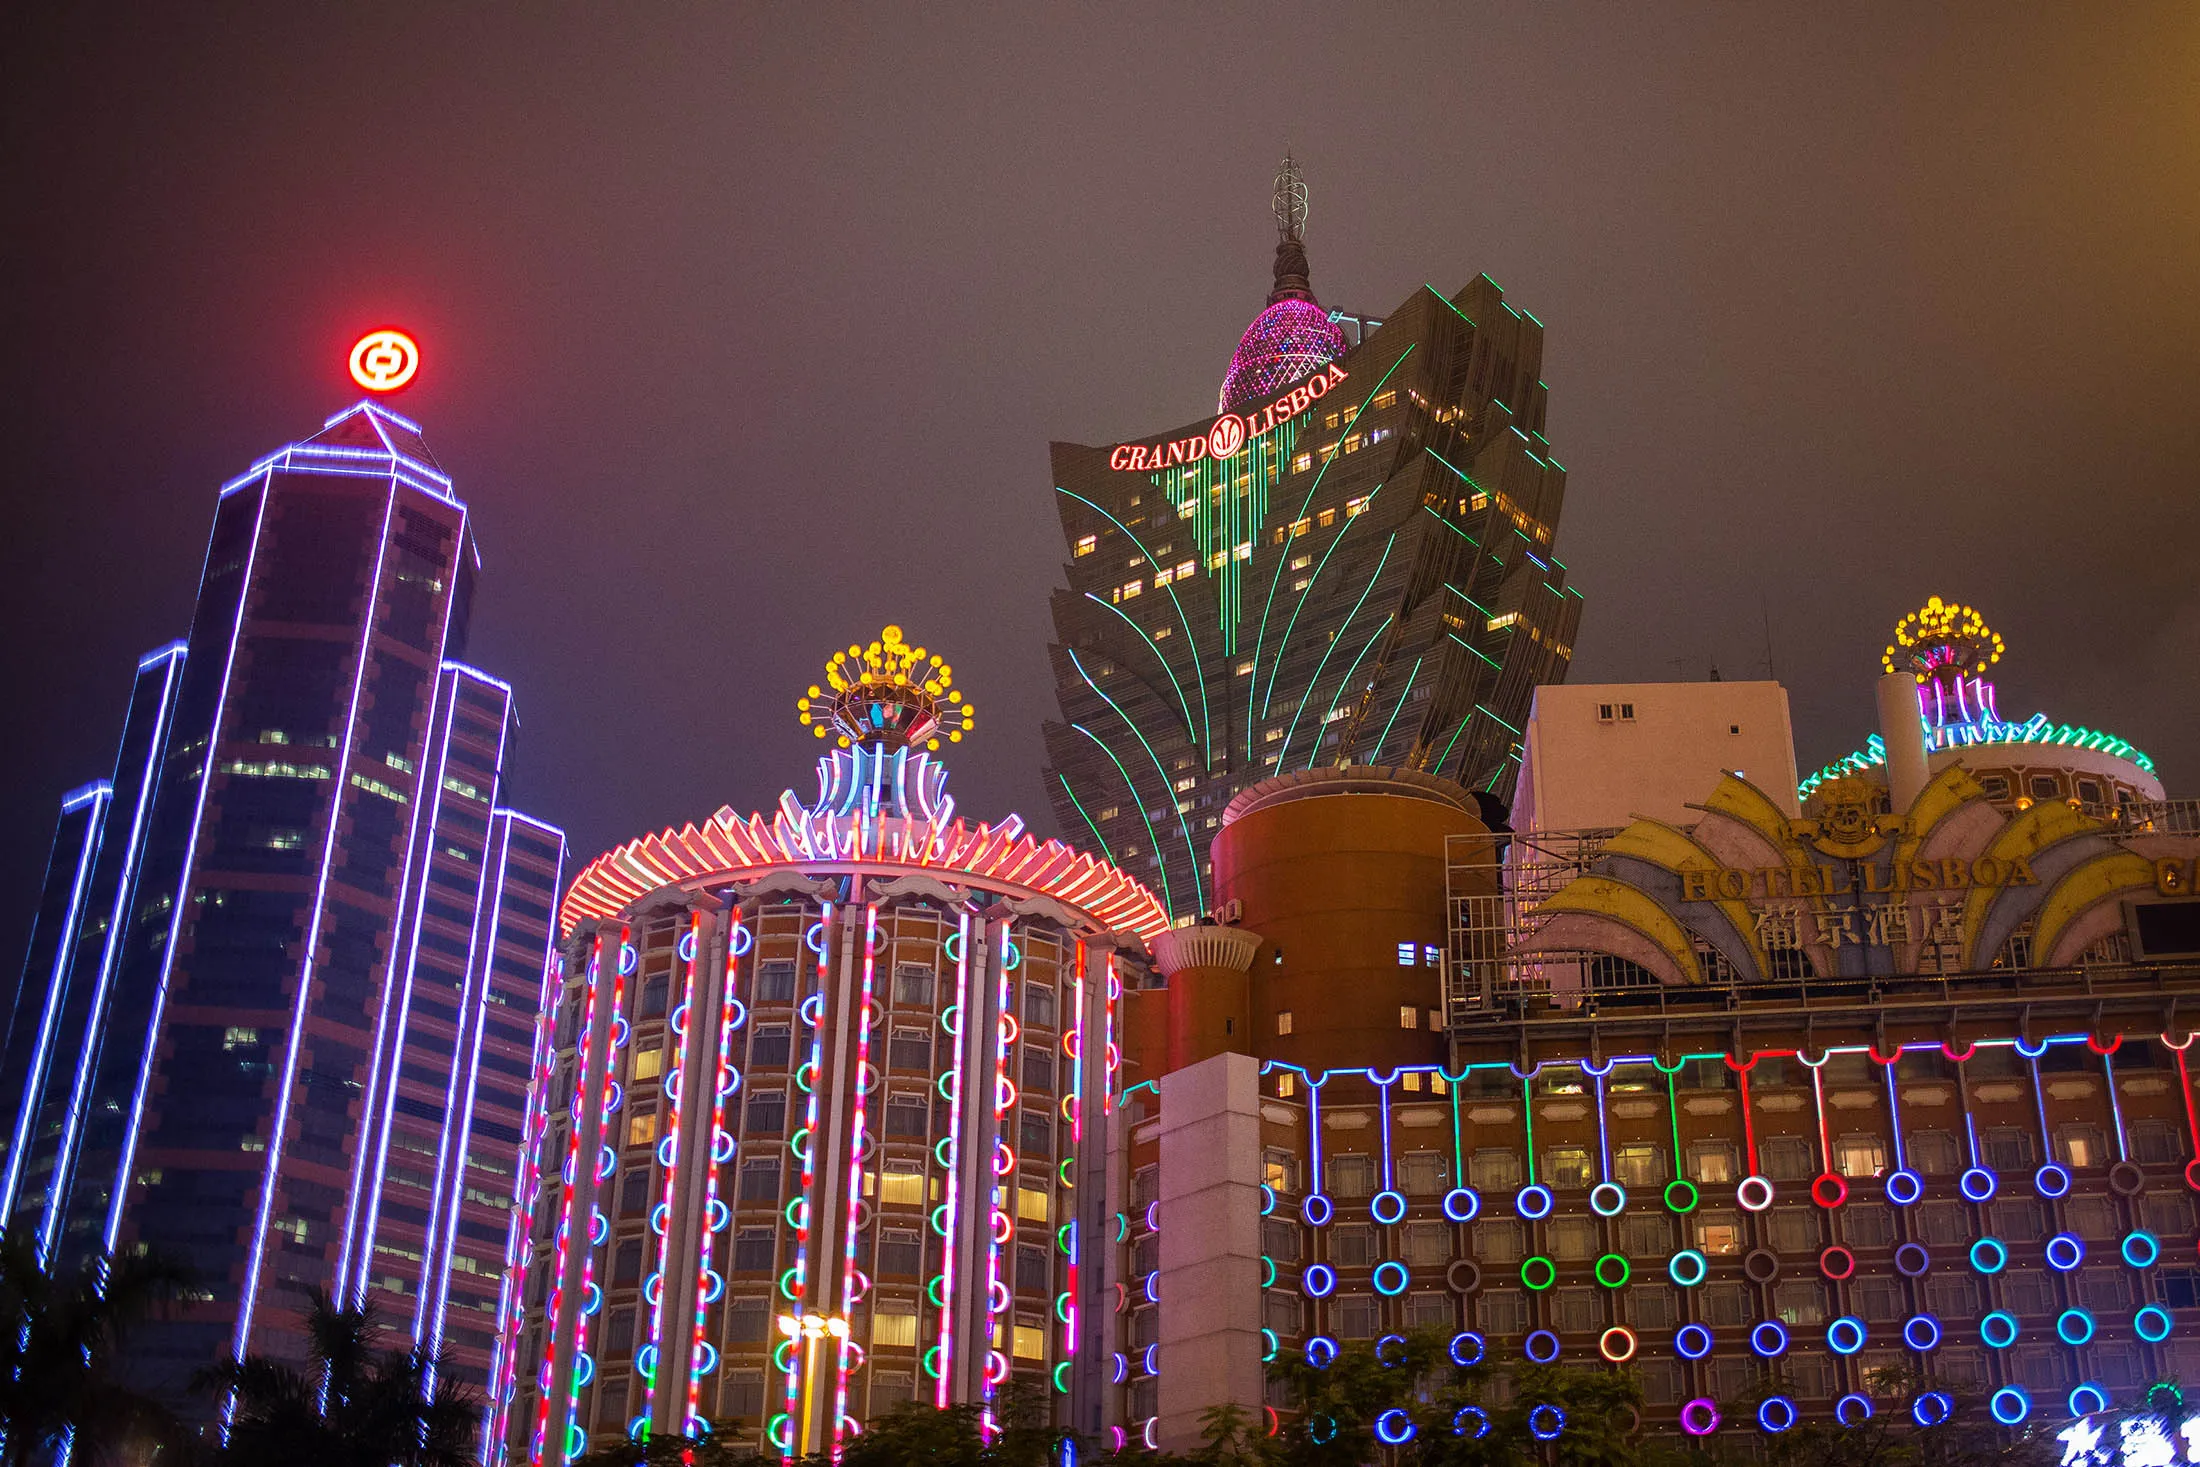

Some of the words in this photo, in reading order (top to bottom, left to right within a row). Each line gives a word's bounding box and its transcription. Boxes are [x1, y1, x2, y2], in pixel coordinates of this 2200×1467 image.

[1110, 435, 1208, 472] GRAND
[1246, 363, 1349, 440] LISBOA
[1681, 863, 1855, 902] HOTEL
[1858, 854, 2043, 894] LISBOA
[1753, 897, 1966, 951] 葡京酒店
